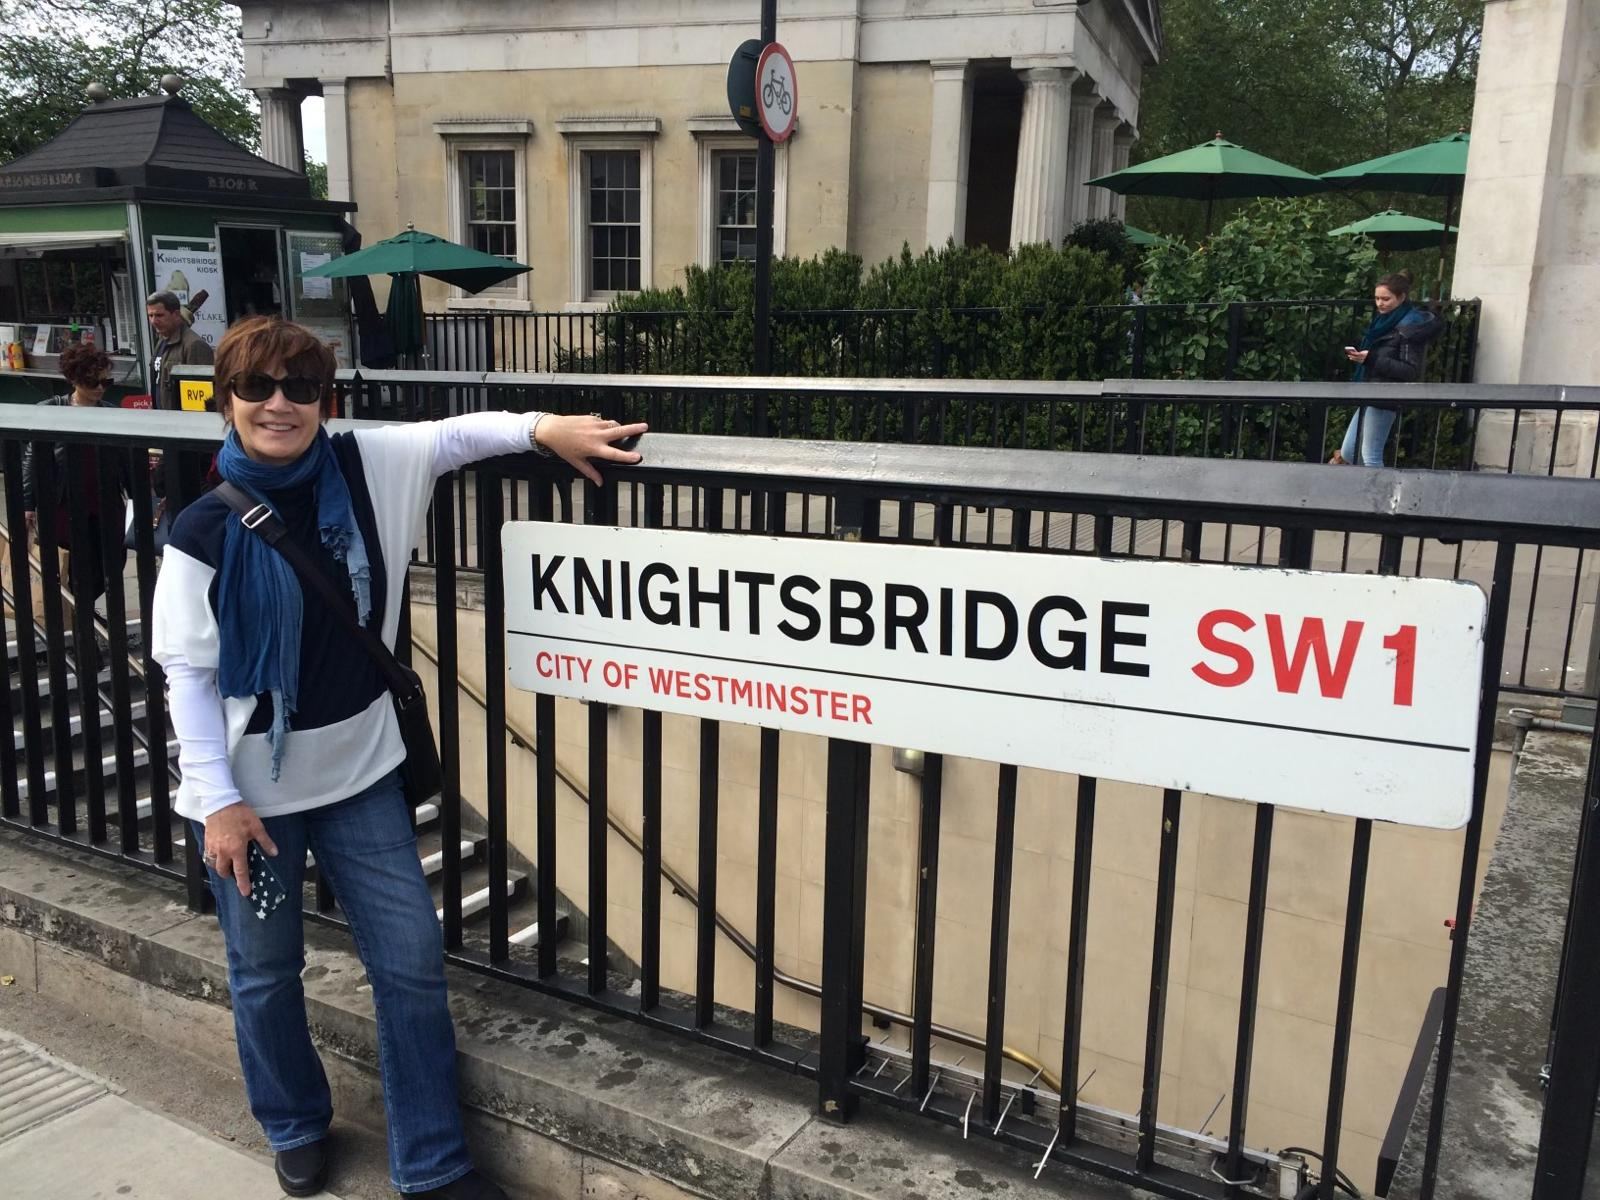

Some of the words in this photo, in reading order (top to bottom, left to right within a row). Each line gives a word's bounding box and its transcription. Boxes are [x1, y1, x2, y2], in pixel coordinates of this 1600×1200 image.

[187, 389, 205, 401] RVP
[531, 553, 1150, 678] KNIGHTSBRIDGE
[1191, 608, 1418, 707] SW1
[535, 651, 593, 684] CITY
[602, 660, 639, 690] OF
[648, 666, 873, 725] WESTMINSTER
